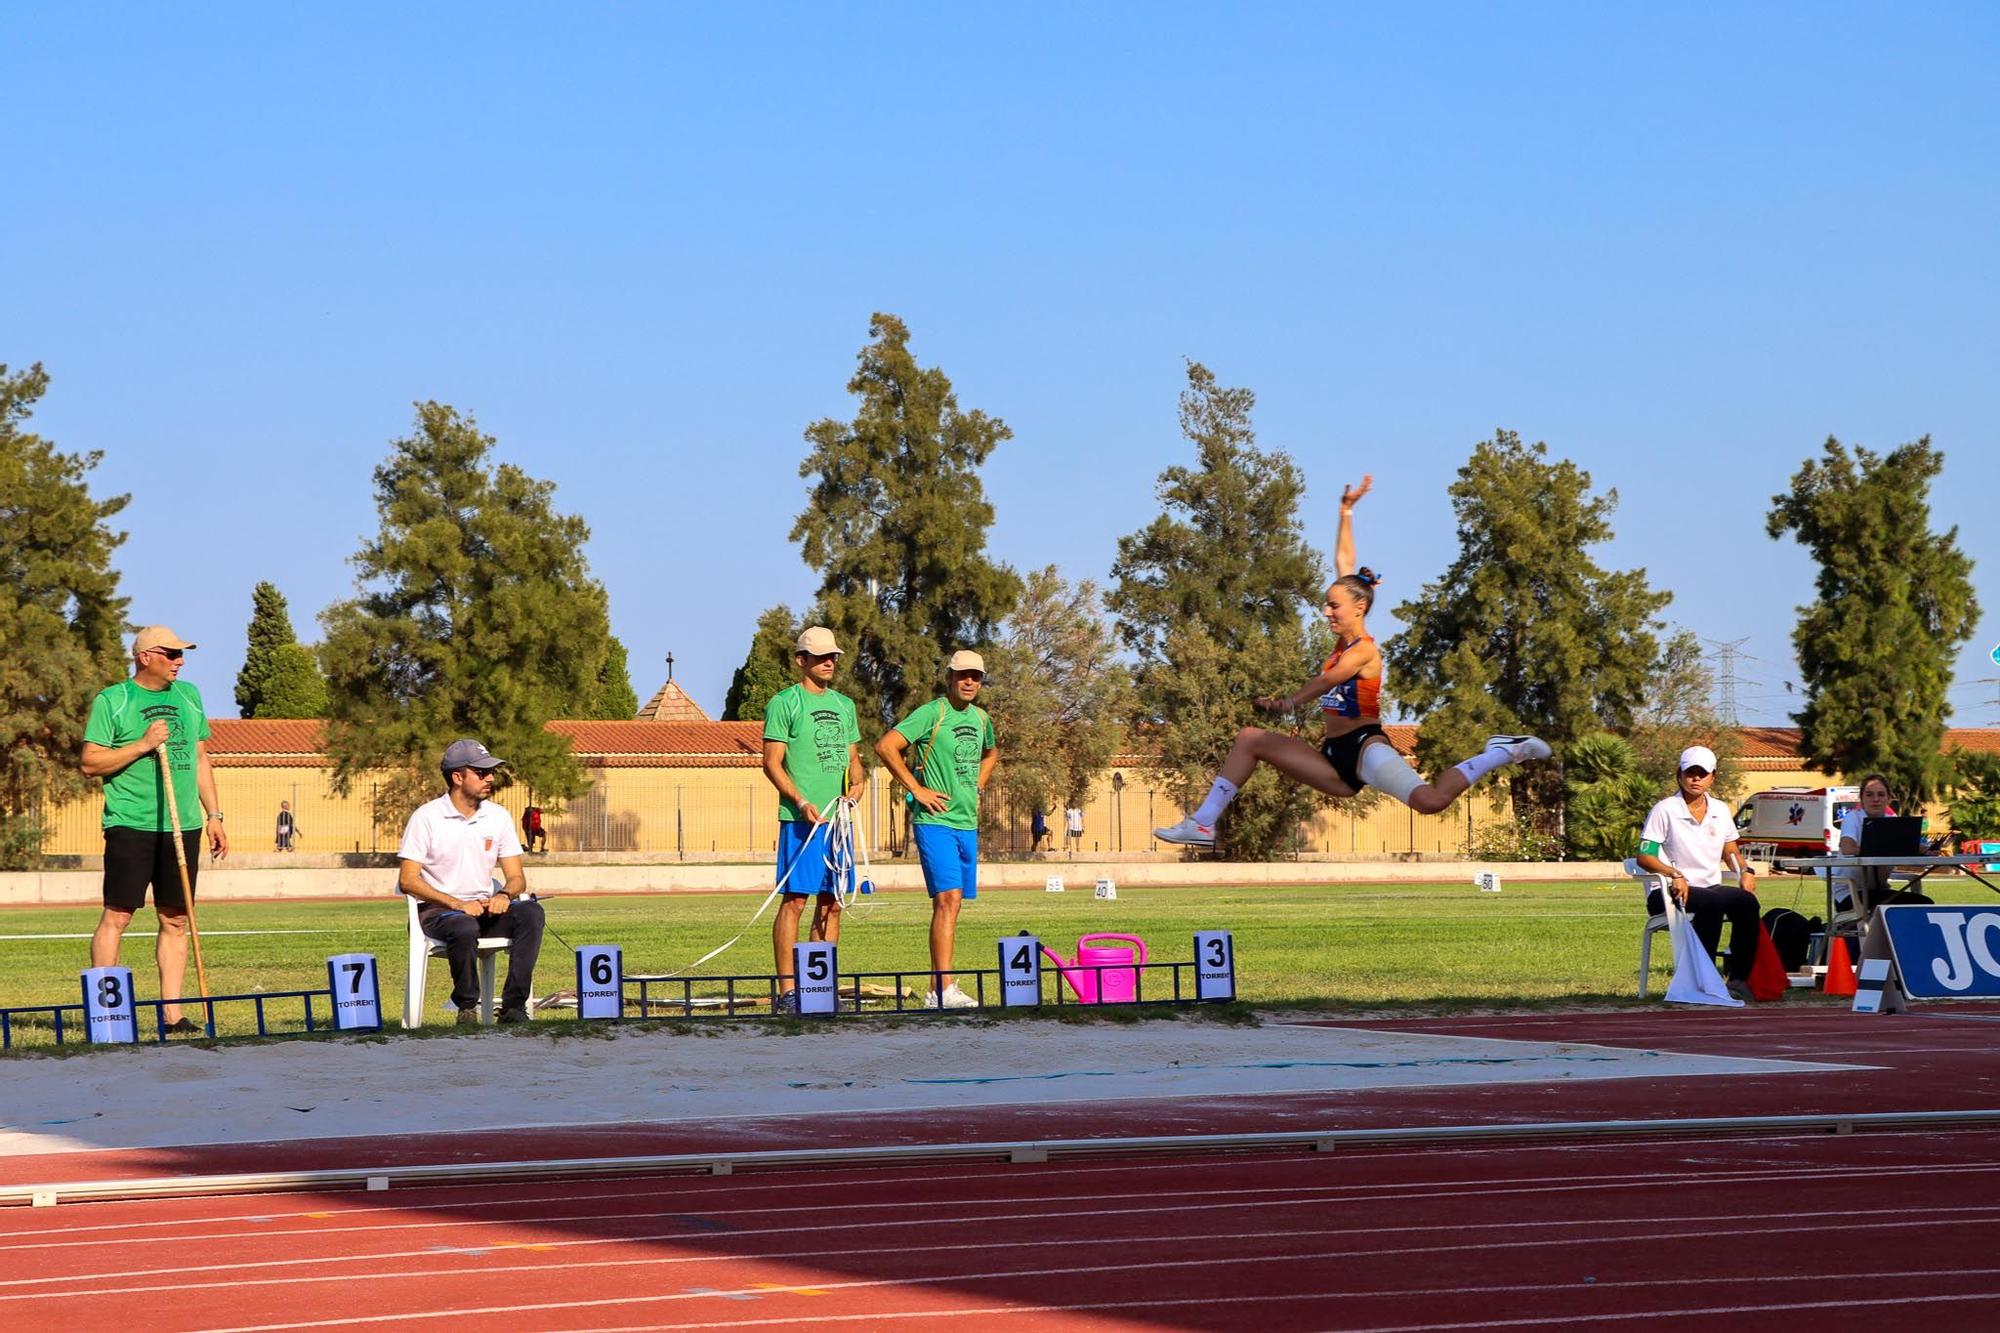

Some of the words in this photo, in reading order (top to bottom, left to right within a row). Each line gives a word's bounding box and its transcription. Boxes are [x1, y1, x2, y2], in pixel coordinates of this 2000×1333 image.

[1096, 886, 1107, 898] 40
[1011, 944, 1032, 974] 4
[1207, 938, 1226, 968] 3
[590, 953, 612, 985] 6
[807, 951, 829, 981] 5
[342, 963, 365, 993] 7
[1200, 972, 1230, 980] TORRENT
[1005, 979, 1036, 987] TORRENT
[97, 976, 123, 1009] 8
[583, 990, 618, 998] TORRENT
[800, 986, 833, 994] TORRENT
[338, 999, 375, 1009] TORRENT
[91, 1014, 131, 1024] TORRENT
